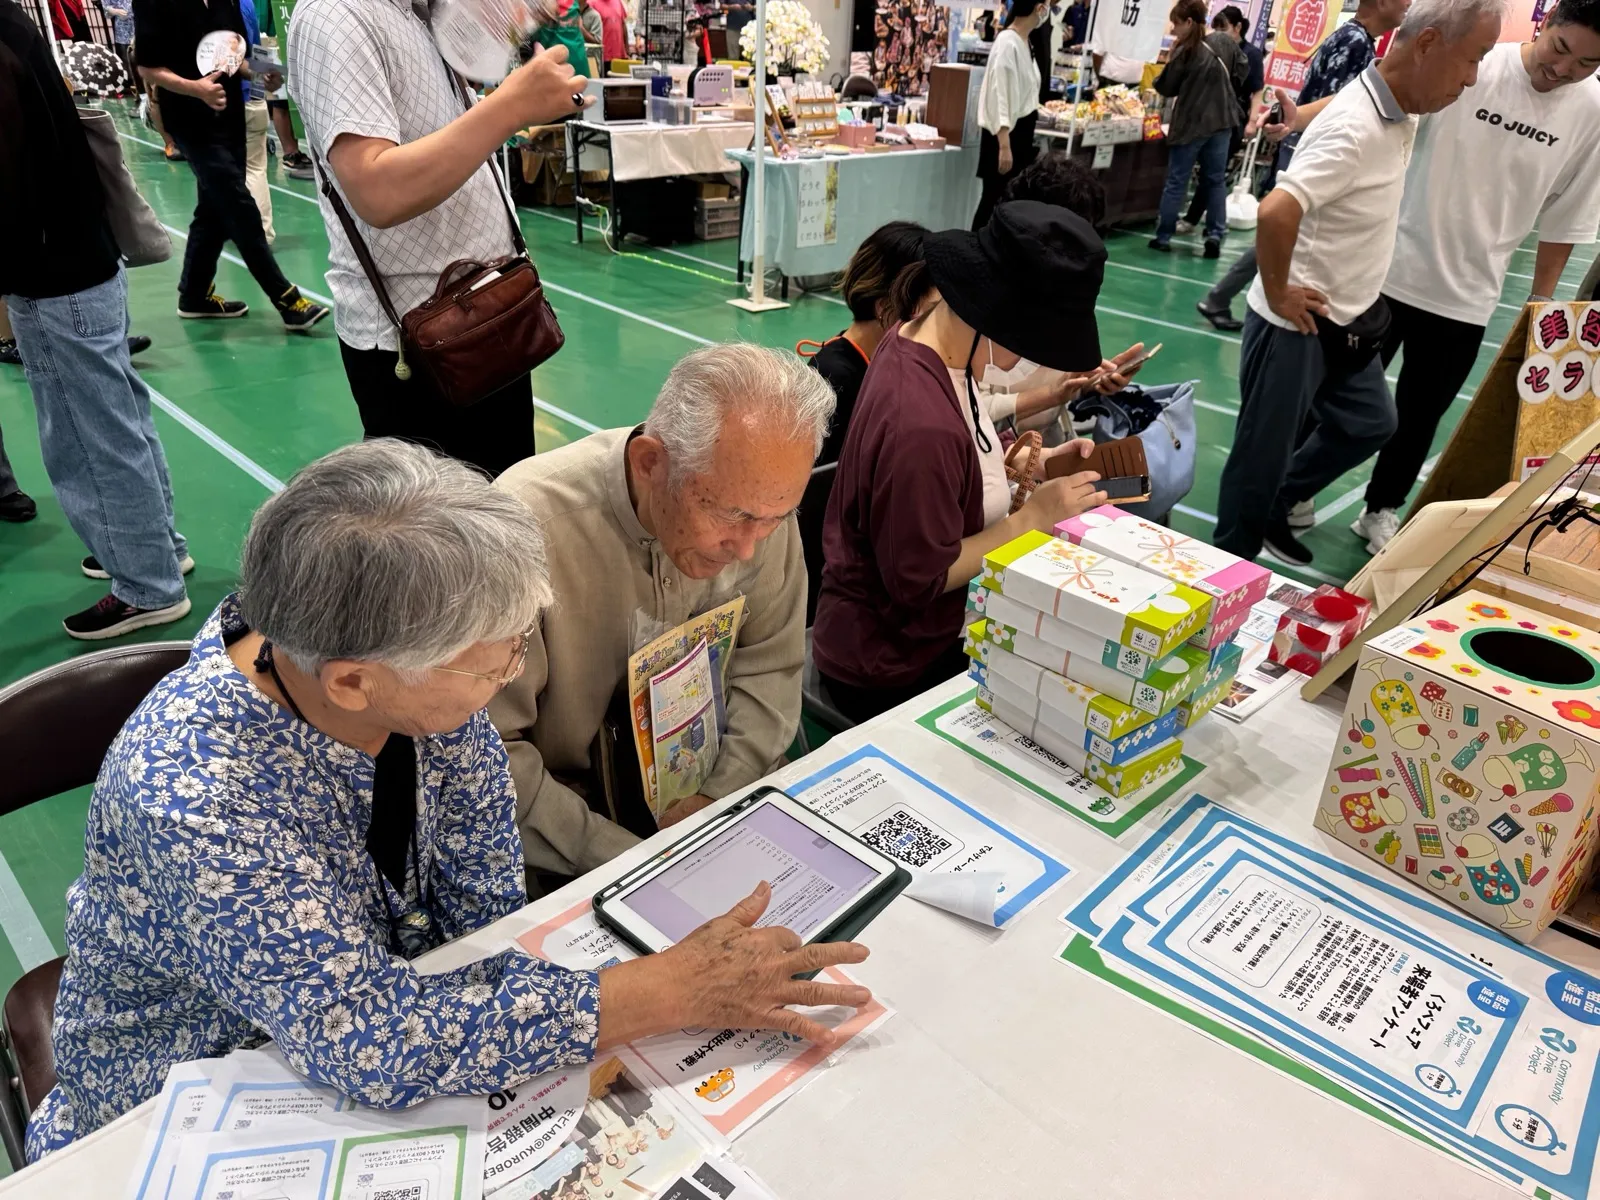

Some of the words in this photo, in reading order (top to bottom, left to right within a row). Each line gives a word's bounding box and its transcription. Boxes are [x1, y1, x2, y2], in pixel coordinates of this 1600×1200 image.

[1270, 58, 1309, 84] 販売
[1475, 108, 1502, 125] GO
[1503, 120, 1559, 147] JUICY
[1525, 361, 1584, 393] セラ
[1318, 915, 1332, 929] します。
[1339, 934, 1370, 969] として実施します。
[1492, 994, 1510, 1012] 粗品
[1561, 980, 1585, 1007] 進呈
[1366, 964, 1433, 1051] 来場者アンケート
[1402, 991, 1446, 1049] くろべフェア
[753, 1034, 777, 1052] Project
[765, 1039, 783, 1053] Drive
[1443, 1028, 1458, 1047] Project
[1455, 1033, 1467, 1047] Drive
[750, 1043, 790, 1072] Community
[1455, 1038, 1475, 1067] Community
[1528, 1046, 1544, 1074] Project
[1543, 1052, 1558, 1073] Drive
[1548, 1060, 1571, 1105] Community
[488, 1089, 517, 1110] 10
[484, 1106, 556, 1162] 中間報告
[1524, 1117, 1539, 1143] 所要時間
